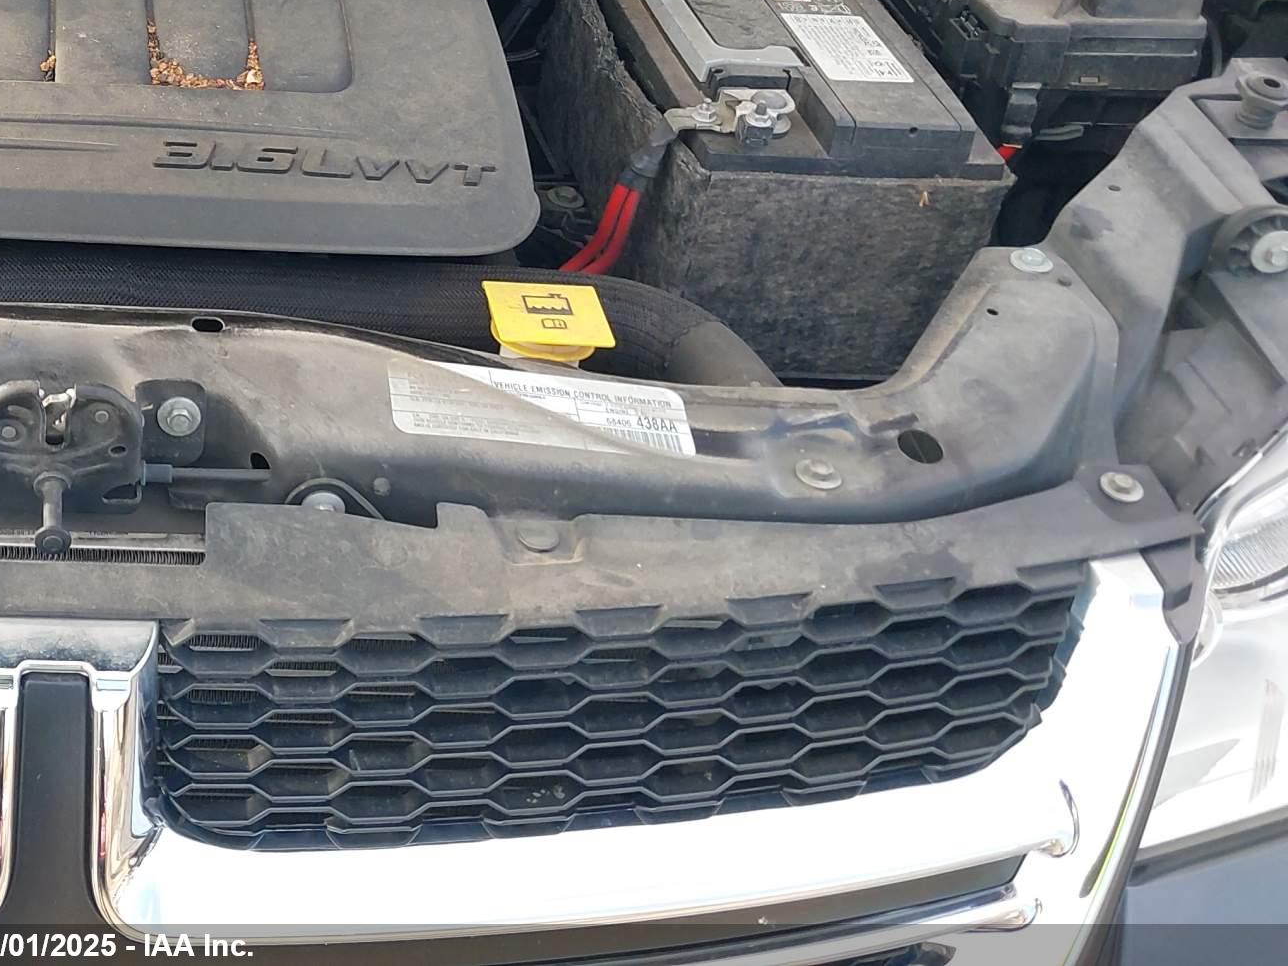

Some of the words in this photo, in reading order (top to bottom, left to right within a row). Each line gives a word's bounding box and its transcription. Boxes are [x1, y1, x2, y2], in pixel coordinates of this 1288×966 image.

[493, 381, 528, 392] VEHICLE
[531, 385, 571, 398] EMISSION
[573, 390, 611, 402] CONTROL
[614, 395, 672, 409] INFORMATION
[636, 416, 678, 433] 438AA
